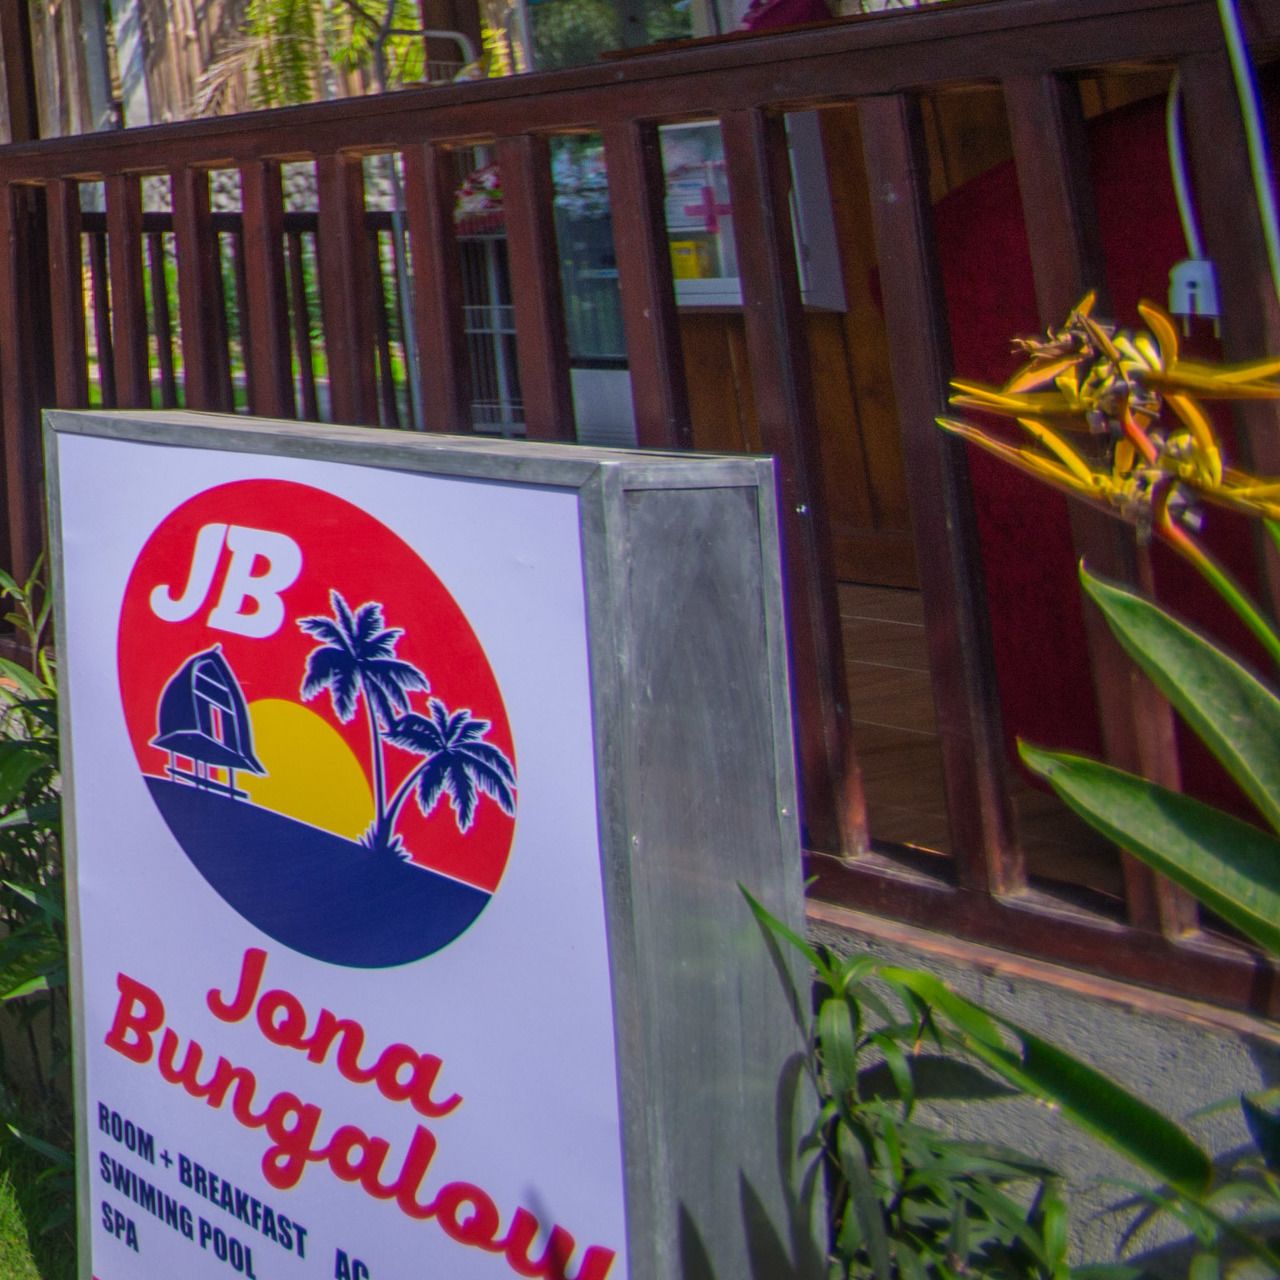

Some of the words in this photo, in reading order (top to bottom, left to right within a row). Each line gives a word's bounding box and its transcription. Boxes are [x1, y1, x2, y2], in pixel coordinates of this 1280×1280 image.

[149, 523, 303, 638] JB
[206, 948, 464, 1118] Jona
[97, 1101, 155, 1164] ROOM
[159, 1149, 173, 1169] +
[178, 1152, 308, 1259] BREAKFAST
[99, 1151, 194, 1241] SWIMING
[198, 1216, 256, 1280] POOL
[101, 1200, 139, 1253] SPA
